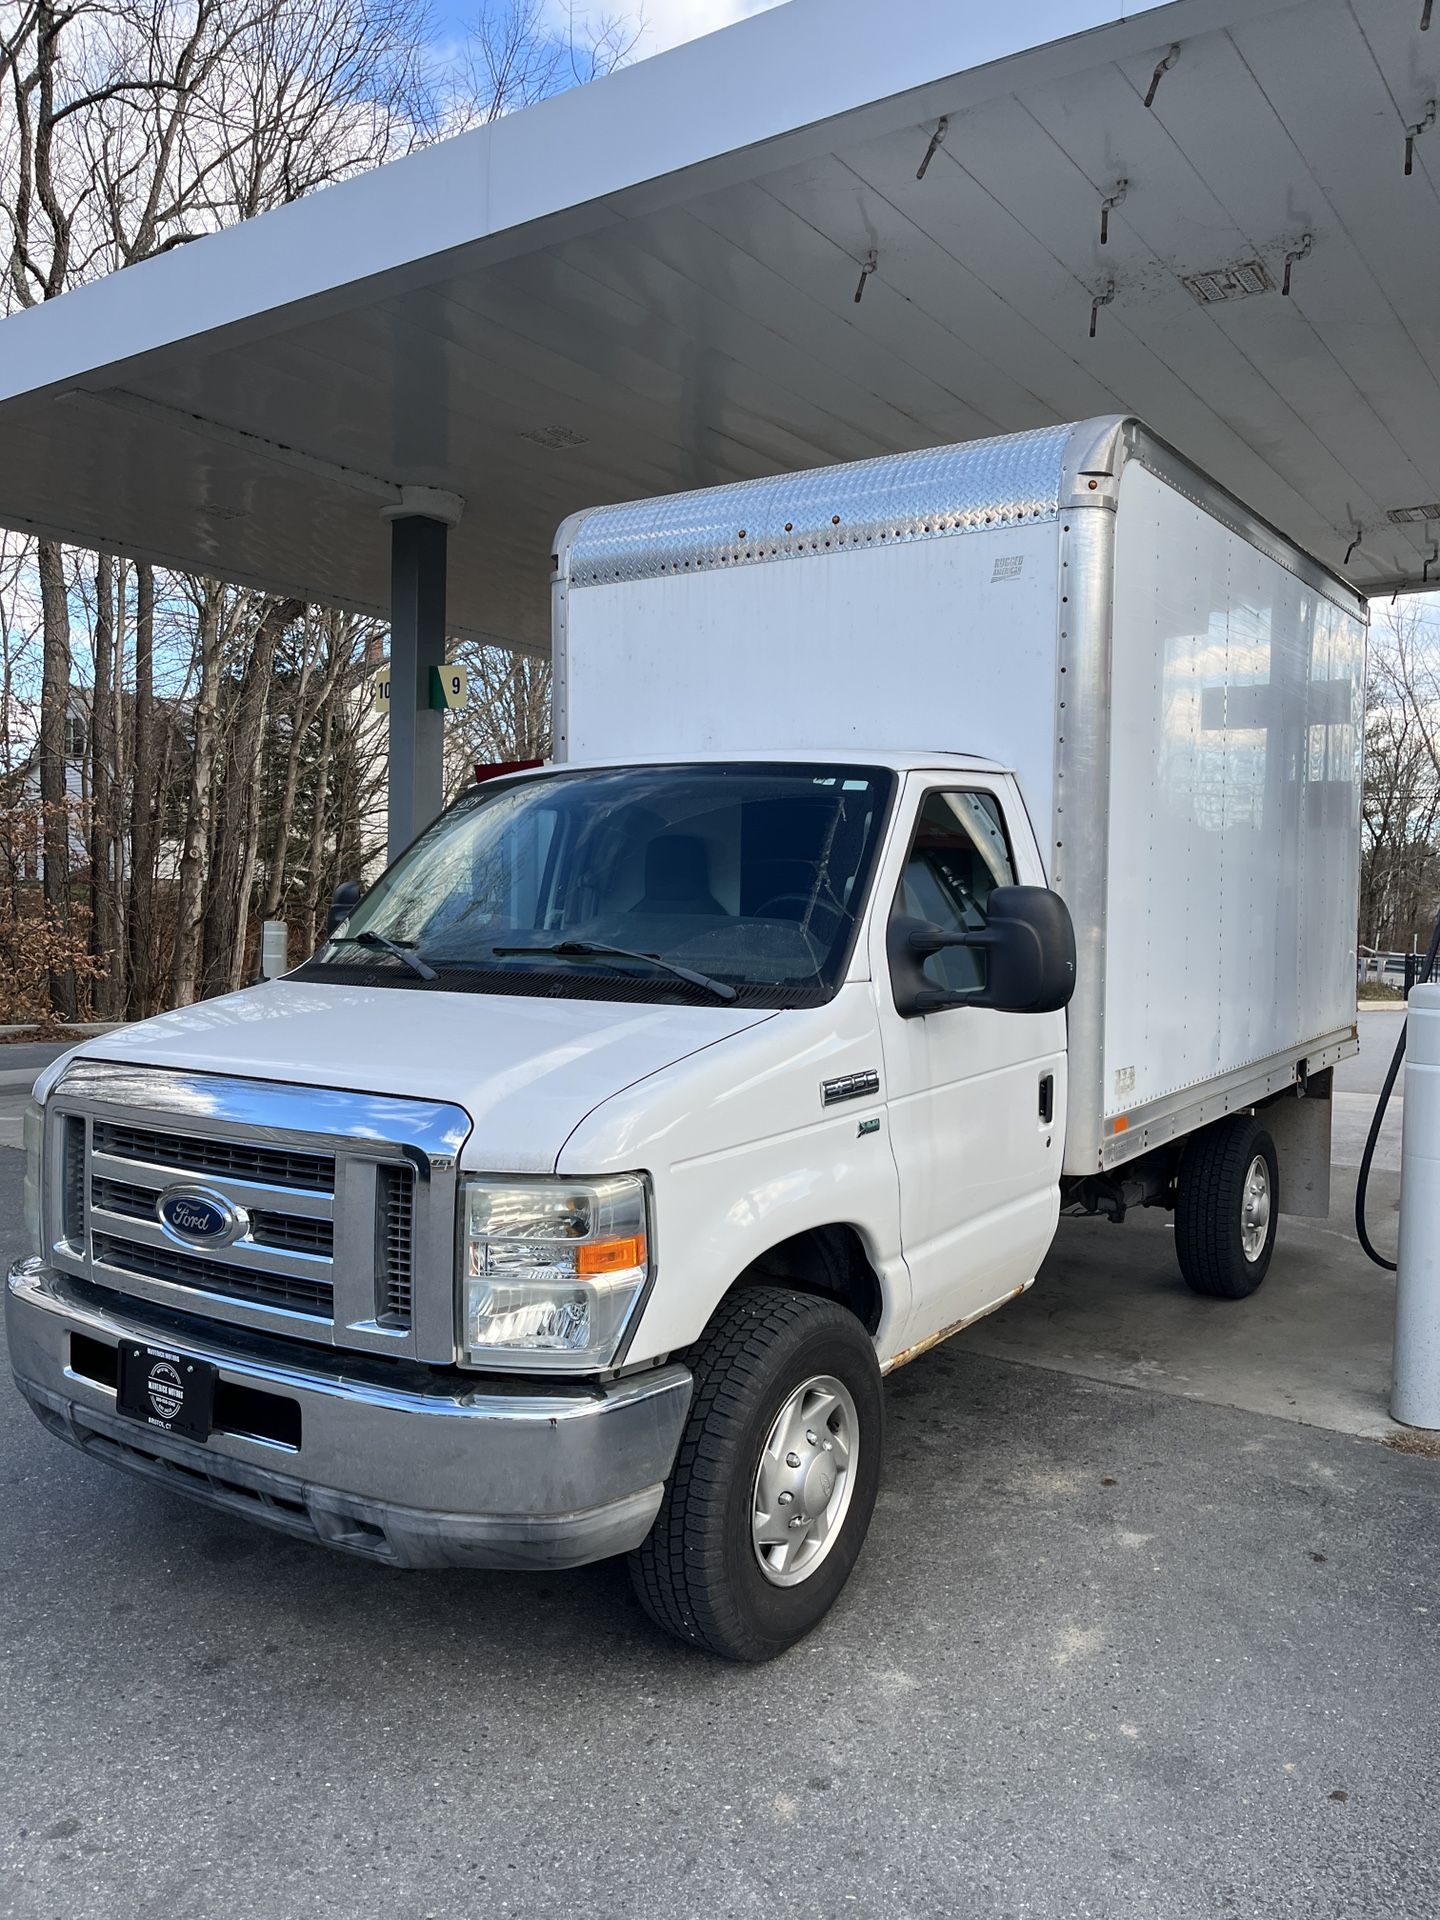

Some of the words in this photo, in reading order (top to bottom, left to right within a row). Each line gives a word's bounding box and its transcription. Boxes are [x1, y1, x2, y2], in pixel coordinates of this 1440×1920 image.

[451, 676, 461, 695] 9
[172, 1201, 210, 1231] Ford
[148, 1380, 168, 1394] MAVERICK
[168, 1386, 183, 1400] MOTORS
